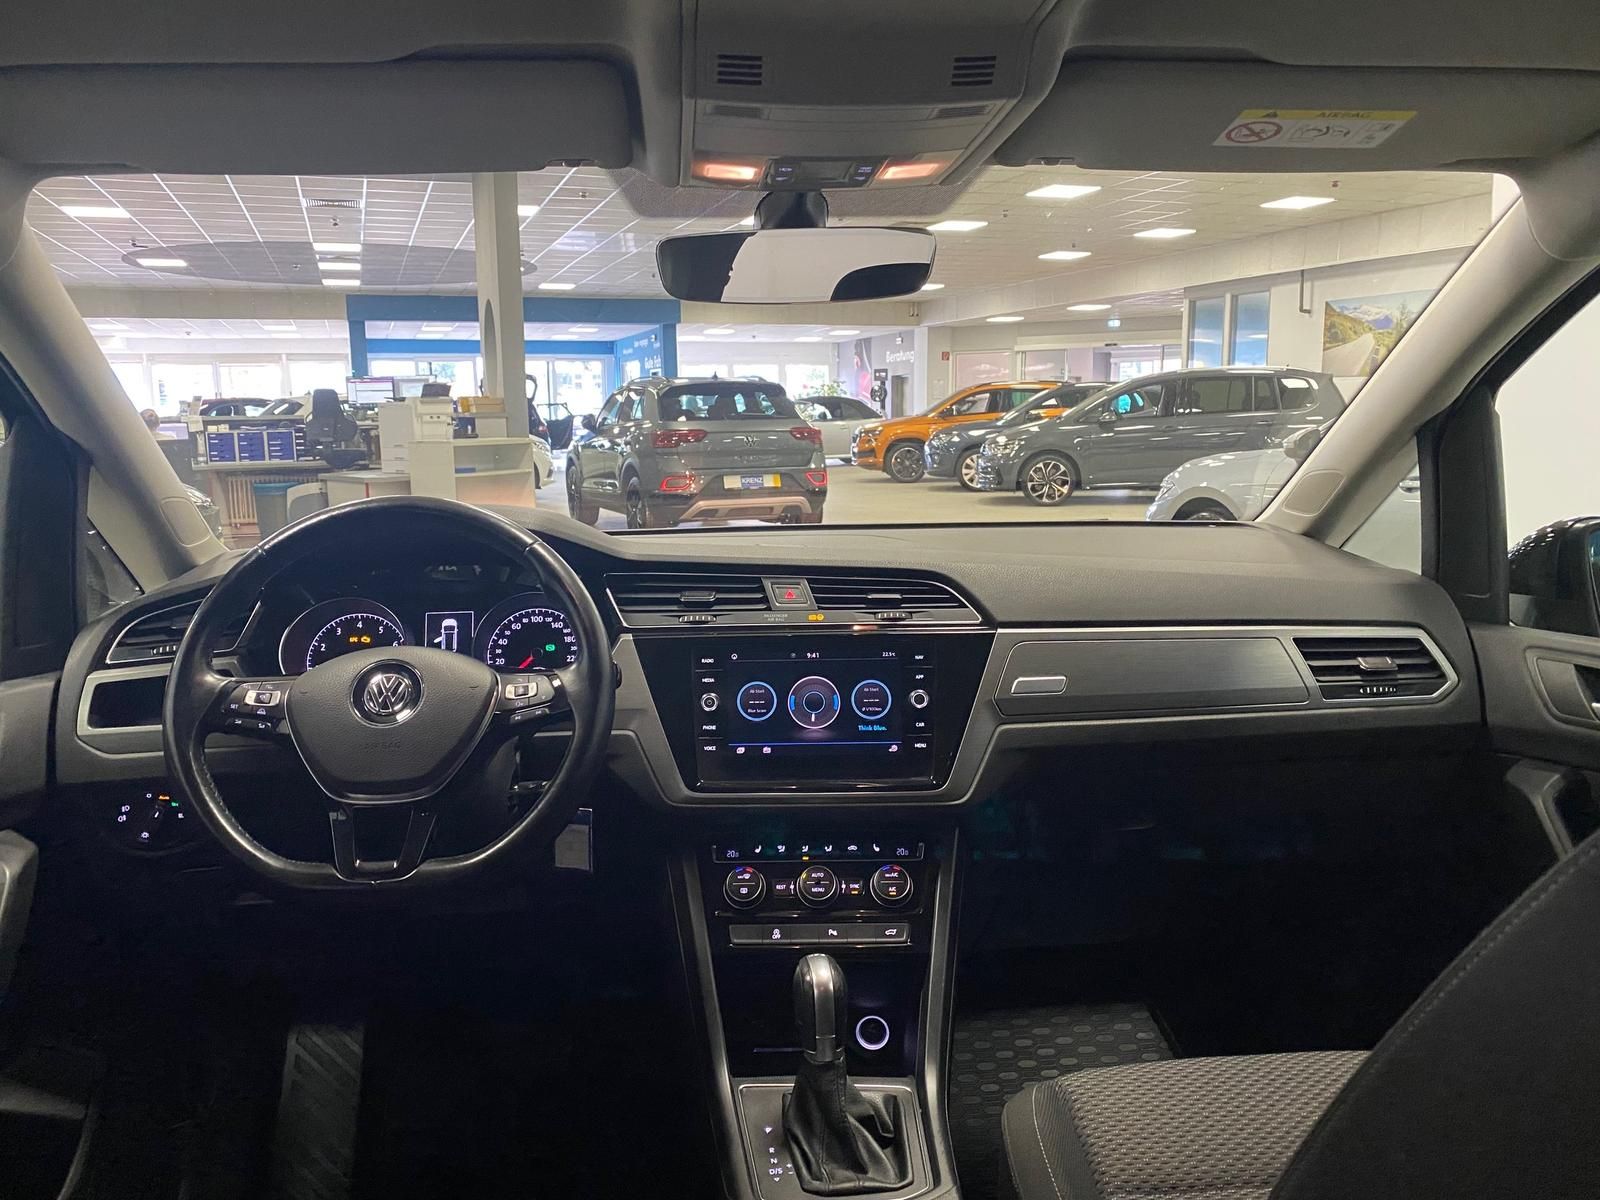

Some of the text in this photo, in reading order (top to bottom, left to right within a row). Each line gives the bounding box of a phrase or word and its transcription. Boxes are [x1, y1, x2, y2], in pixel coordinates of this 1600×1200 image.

[885, 350, 915, 363] Beratung
[356, 620, 363, 629] 4
[511, 622, 522, 630] 60
[551, 621, 563, 629] 140
[335, 627, 342, 636] 3
[378, 626, 384, 634] 5
[563, 635, 576, 643] 180
[320, 643, 326, 651] 2
[495, 657, 505, 665] 20
[768, 1167, 784, 1176] D/S
